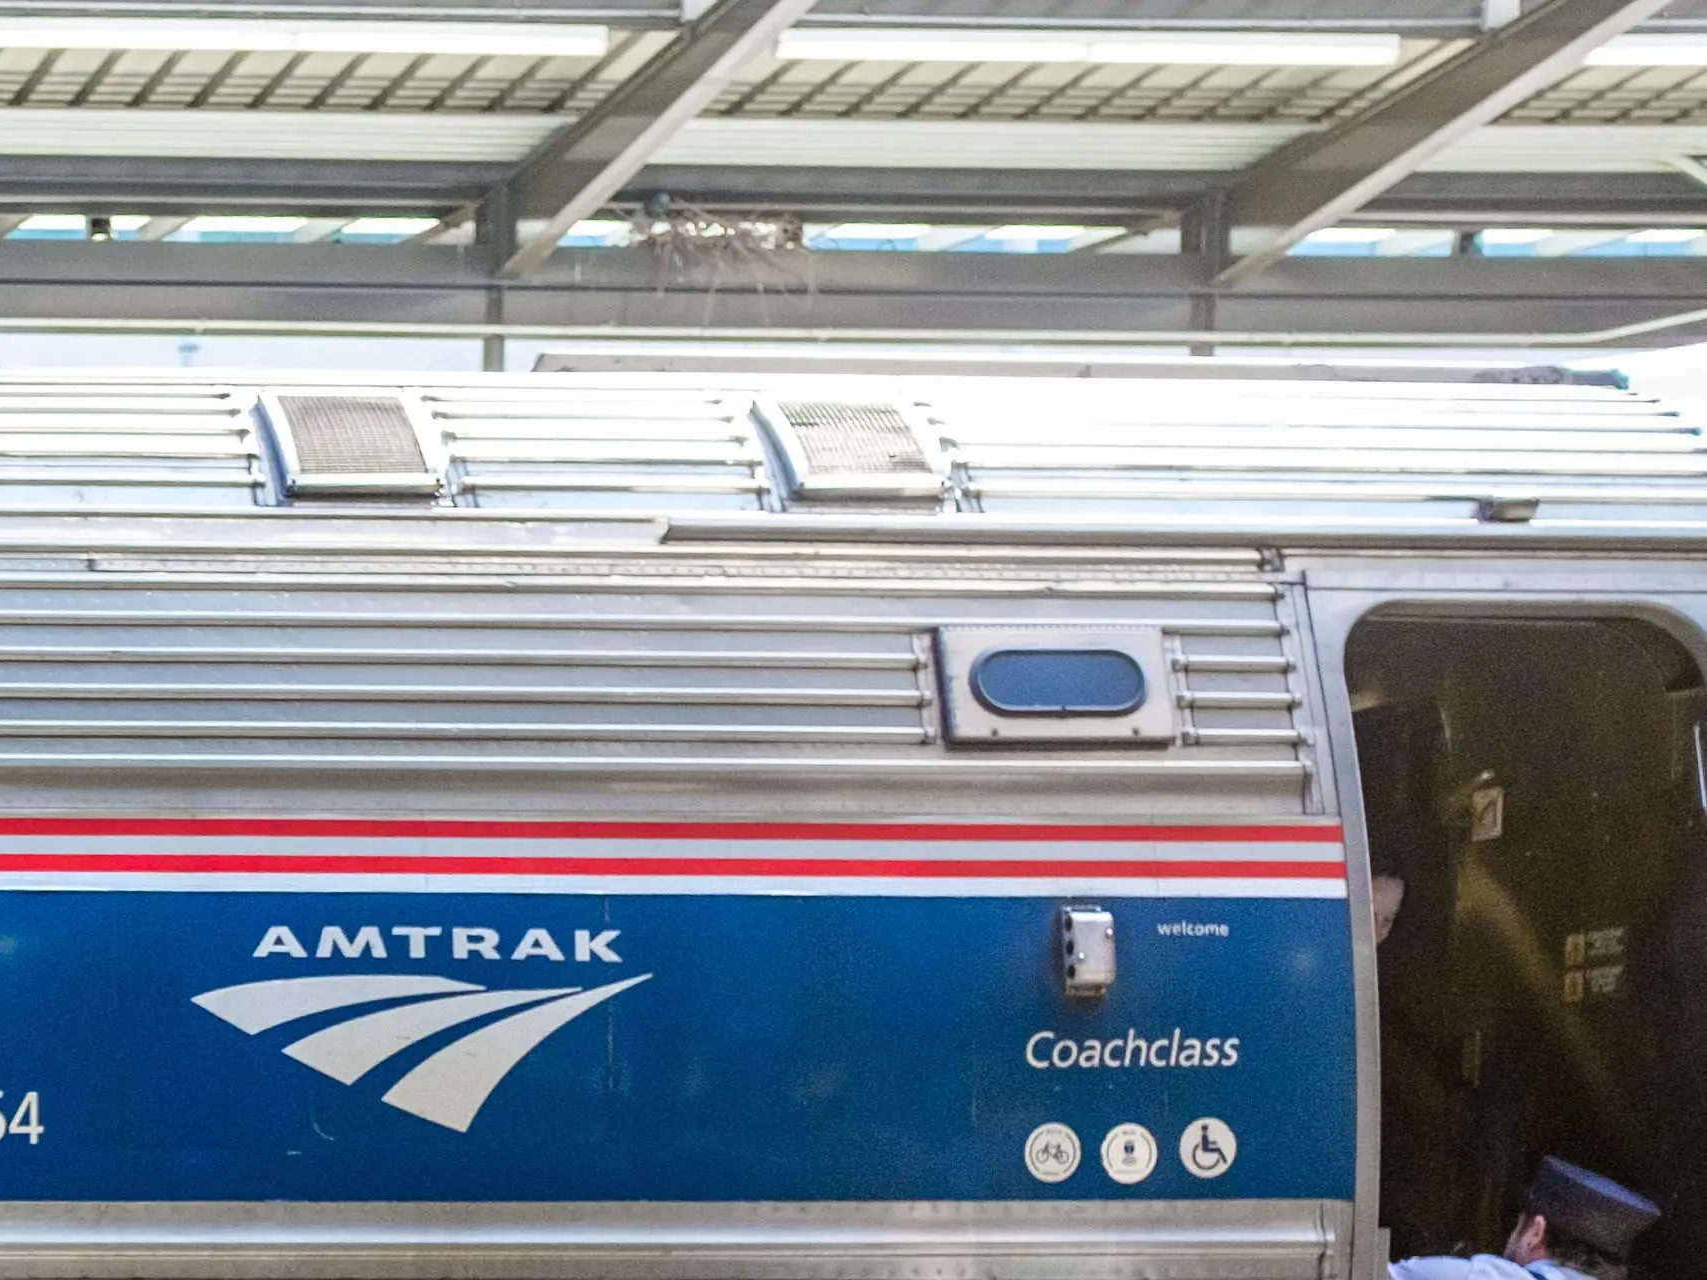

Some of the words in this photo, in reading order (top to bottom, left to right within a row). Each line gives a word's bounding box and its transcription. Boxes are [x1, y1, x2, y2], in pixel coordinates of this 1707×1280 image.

[251, 925, 624, 964] AMTRAK
[1156, 919, 1230, 938] welcome
[1025, 1027, 1240, 1069] Coachclass
